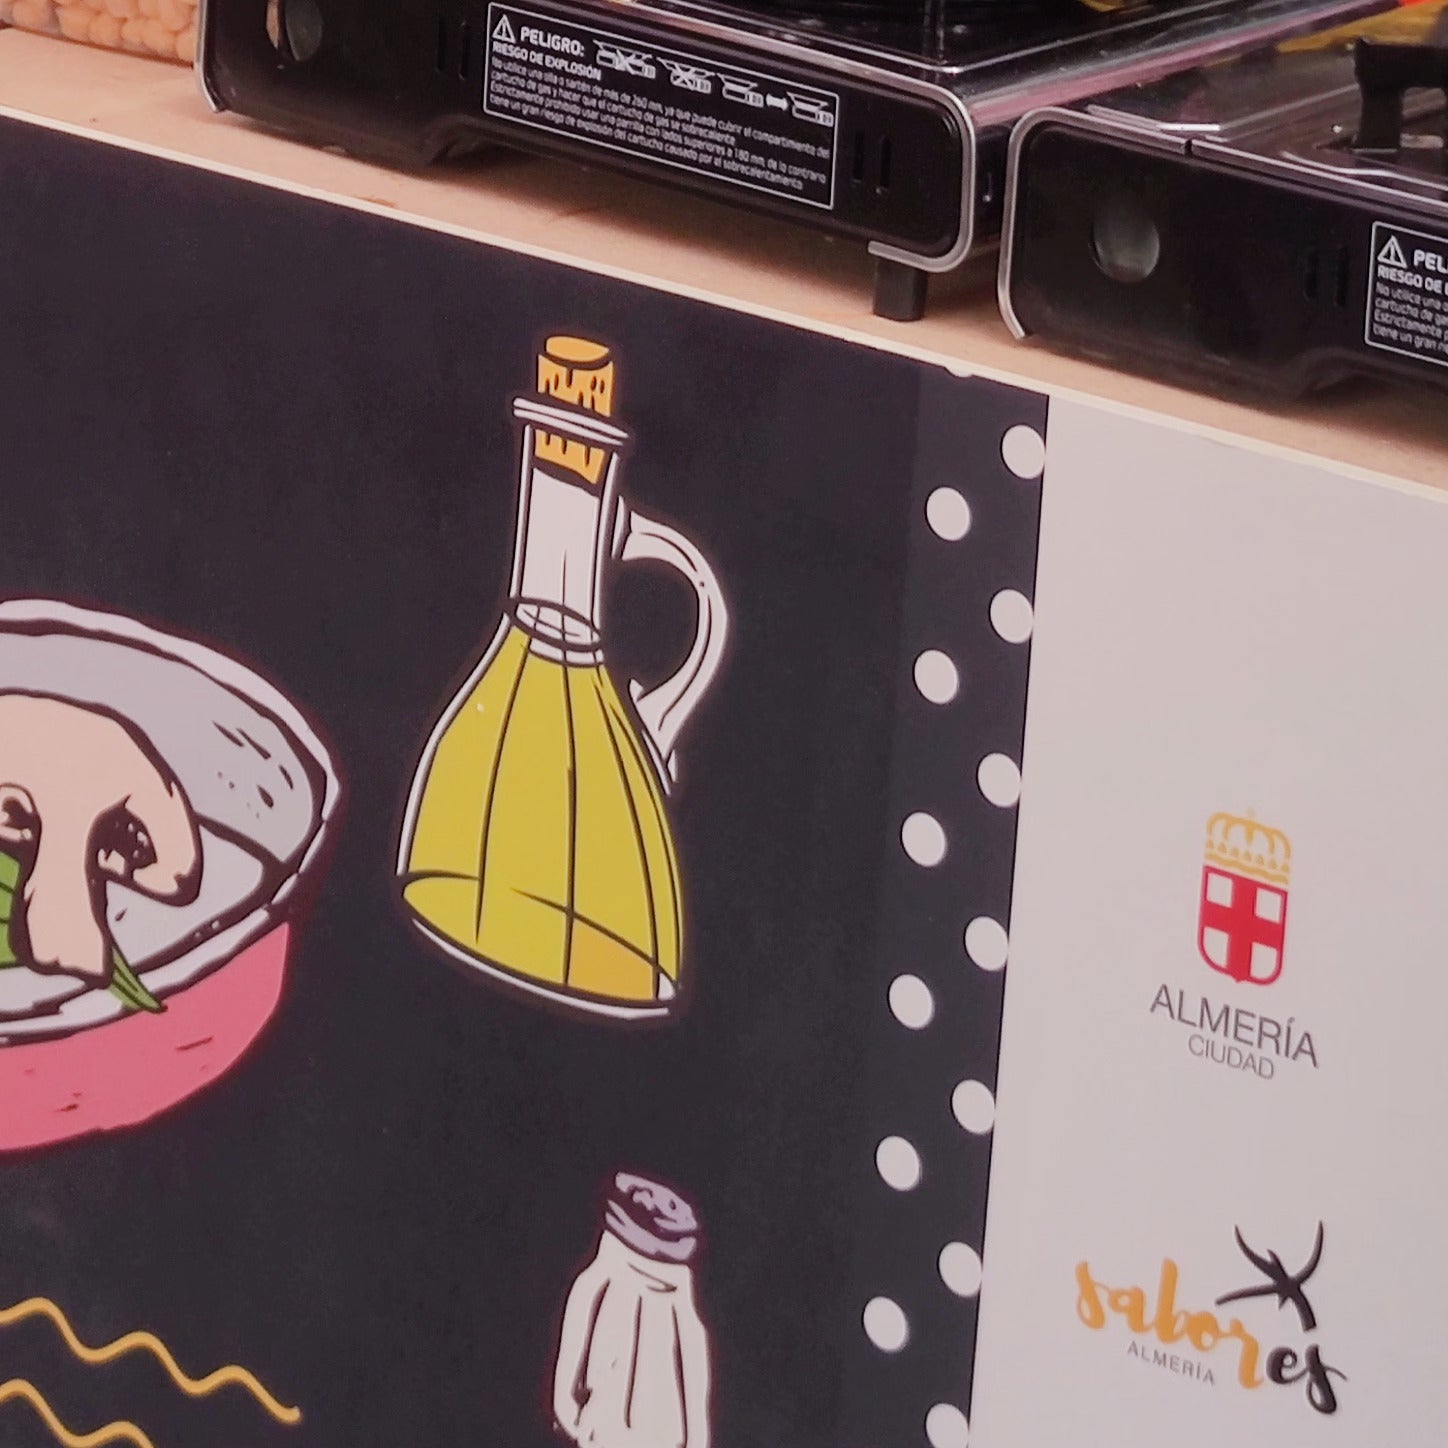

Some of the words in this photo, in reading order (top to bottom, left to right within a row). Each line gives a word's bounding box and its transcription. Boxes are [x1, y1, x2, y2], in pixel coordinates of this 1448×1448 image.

[492, 41, 527, 61] RIESGO
[529, 51, 543, 65] DE
[544, 56, 601, 81] EXPLOSIÓN
[520, 26, 585, 57] PELIGRO:
[1376, 264, 1423, 287] RIESGO
[1424, 277, 1442, 293] DE
[1149, 983, 1320, 1069] ALMERÍA
[1187, 1033, 1275, 1081] CIUDAD
[1127, 1339, 1217, 1386] ALMERÍA
